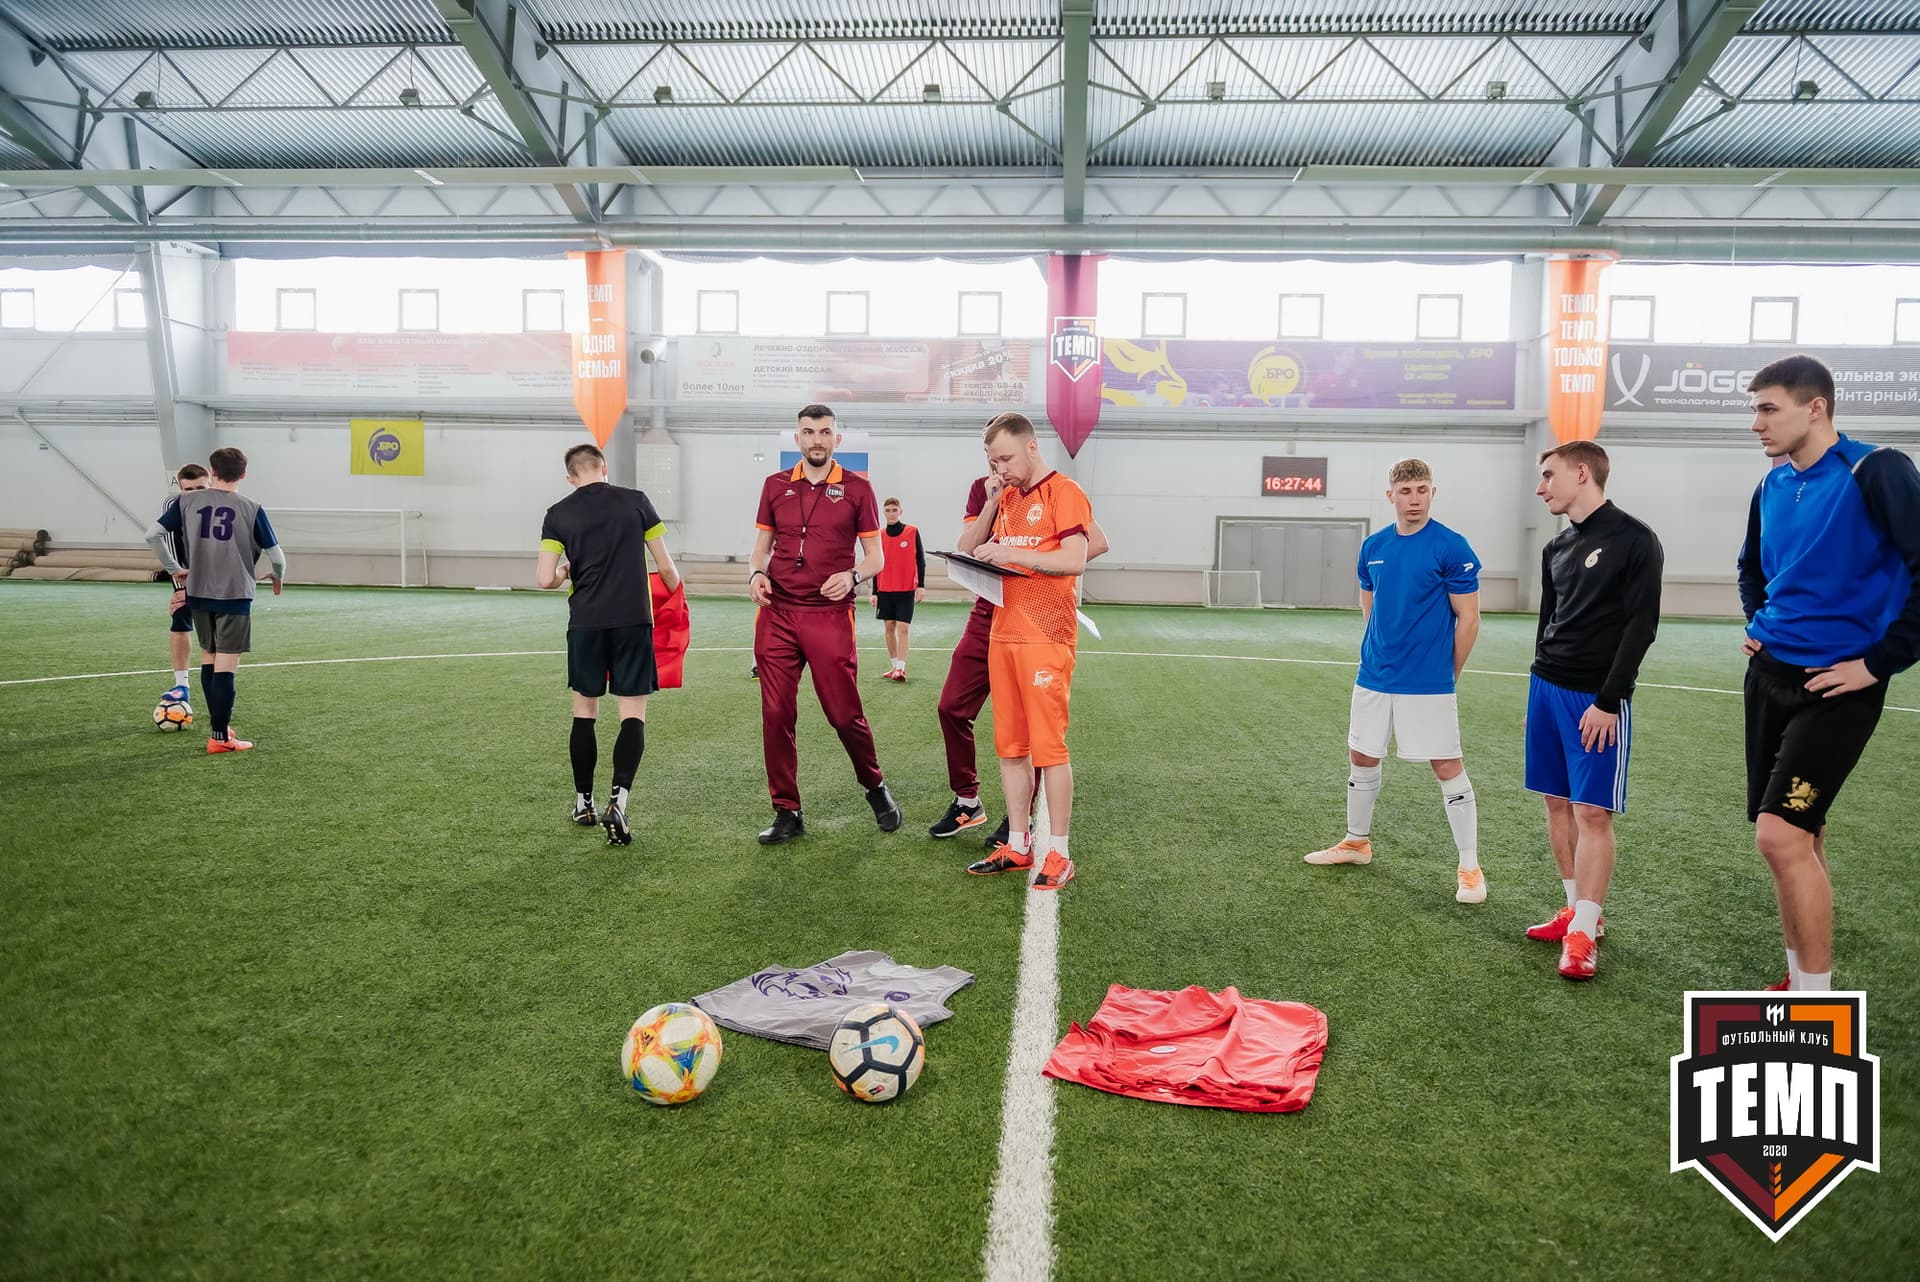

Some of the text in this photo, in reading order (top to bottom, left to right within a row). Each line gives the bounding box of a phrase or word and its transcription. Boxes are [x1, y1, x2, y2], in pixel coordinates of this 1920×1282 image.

[582, 334, 616, 356] ОДНА
[1055, 335, 1097, 358] ТЕМП
[1553, 346, 1603, 368] ТОЛЬКО
[578, 359, 622, 379] СЕМЬЯ!
[754, 364, 795, 374] ДЕТСКИЙ
[1262, 367, 1296, 380] .БРО
[1653, 361, 1758, 394] JÖGE
[1834, 370, 1895, 382] ольная
[683, 382, 714, 392] более
[1560, 373, 1597, 393] ТЕМП!
[1654, 397, 1752, 408] технологии резу
[1265, 476, 1322, 491] 16:27:44
[196, 505, 237, 542] 13
